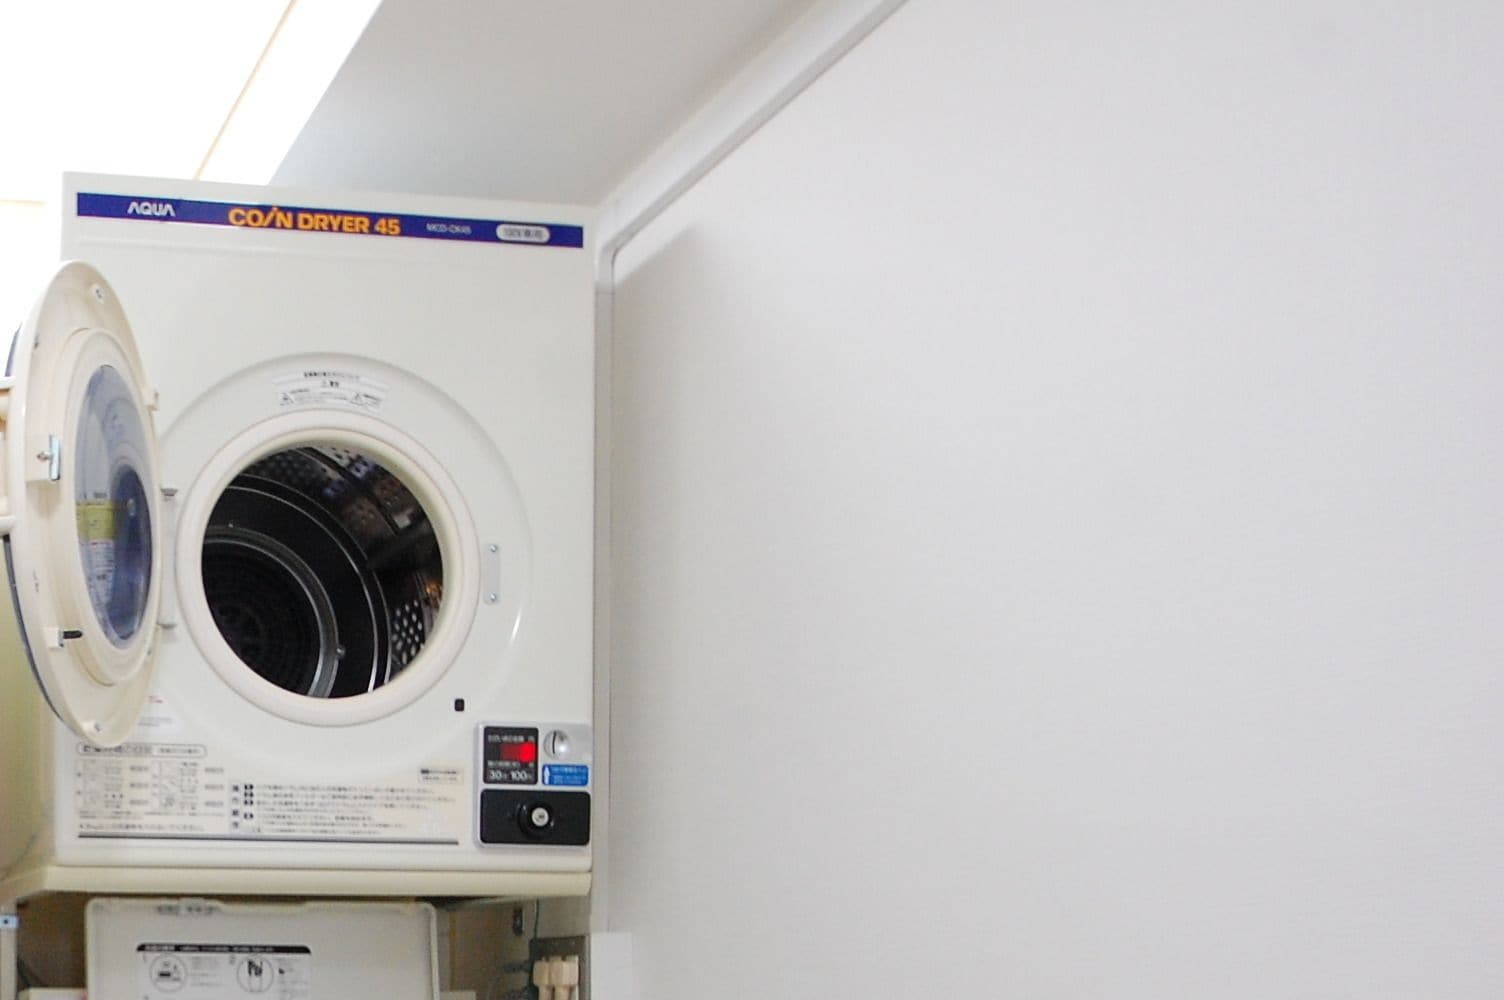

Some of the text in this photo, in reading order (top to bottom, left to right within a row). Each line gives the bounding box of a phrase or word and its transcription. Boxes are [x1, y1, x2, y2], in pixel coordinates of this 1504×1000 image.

[127, 201, 176, 217] AQUA
[228, 205, 401, 236] COIN DRYER 45
